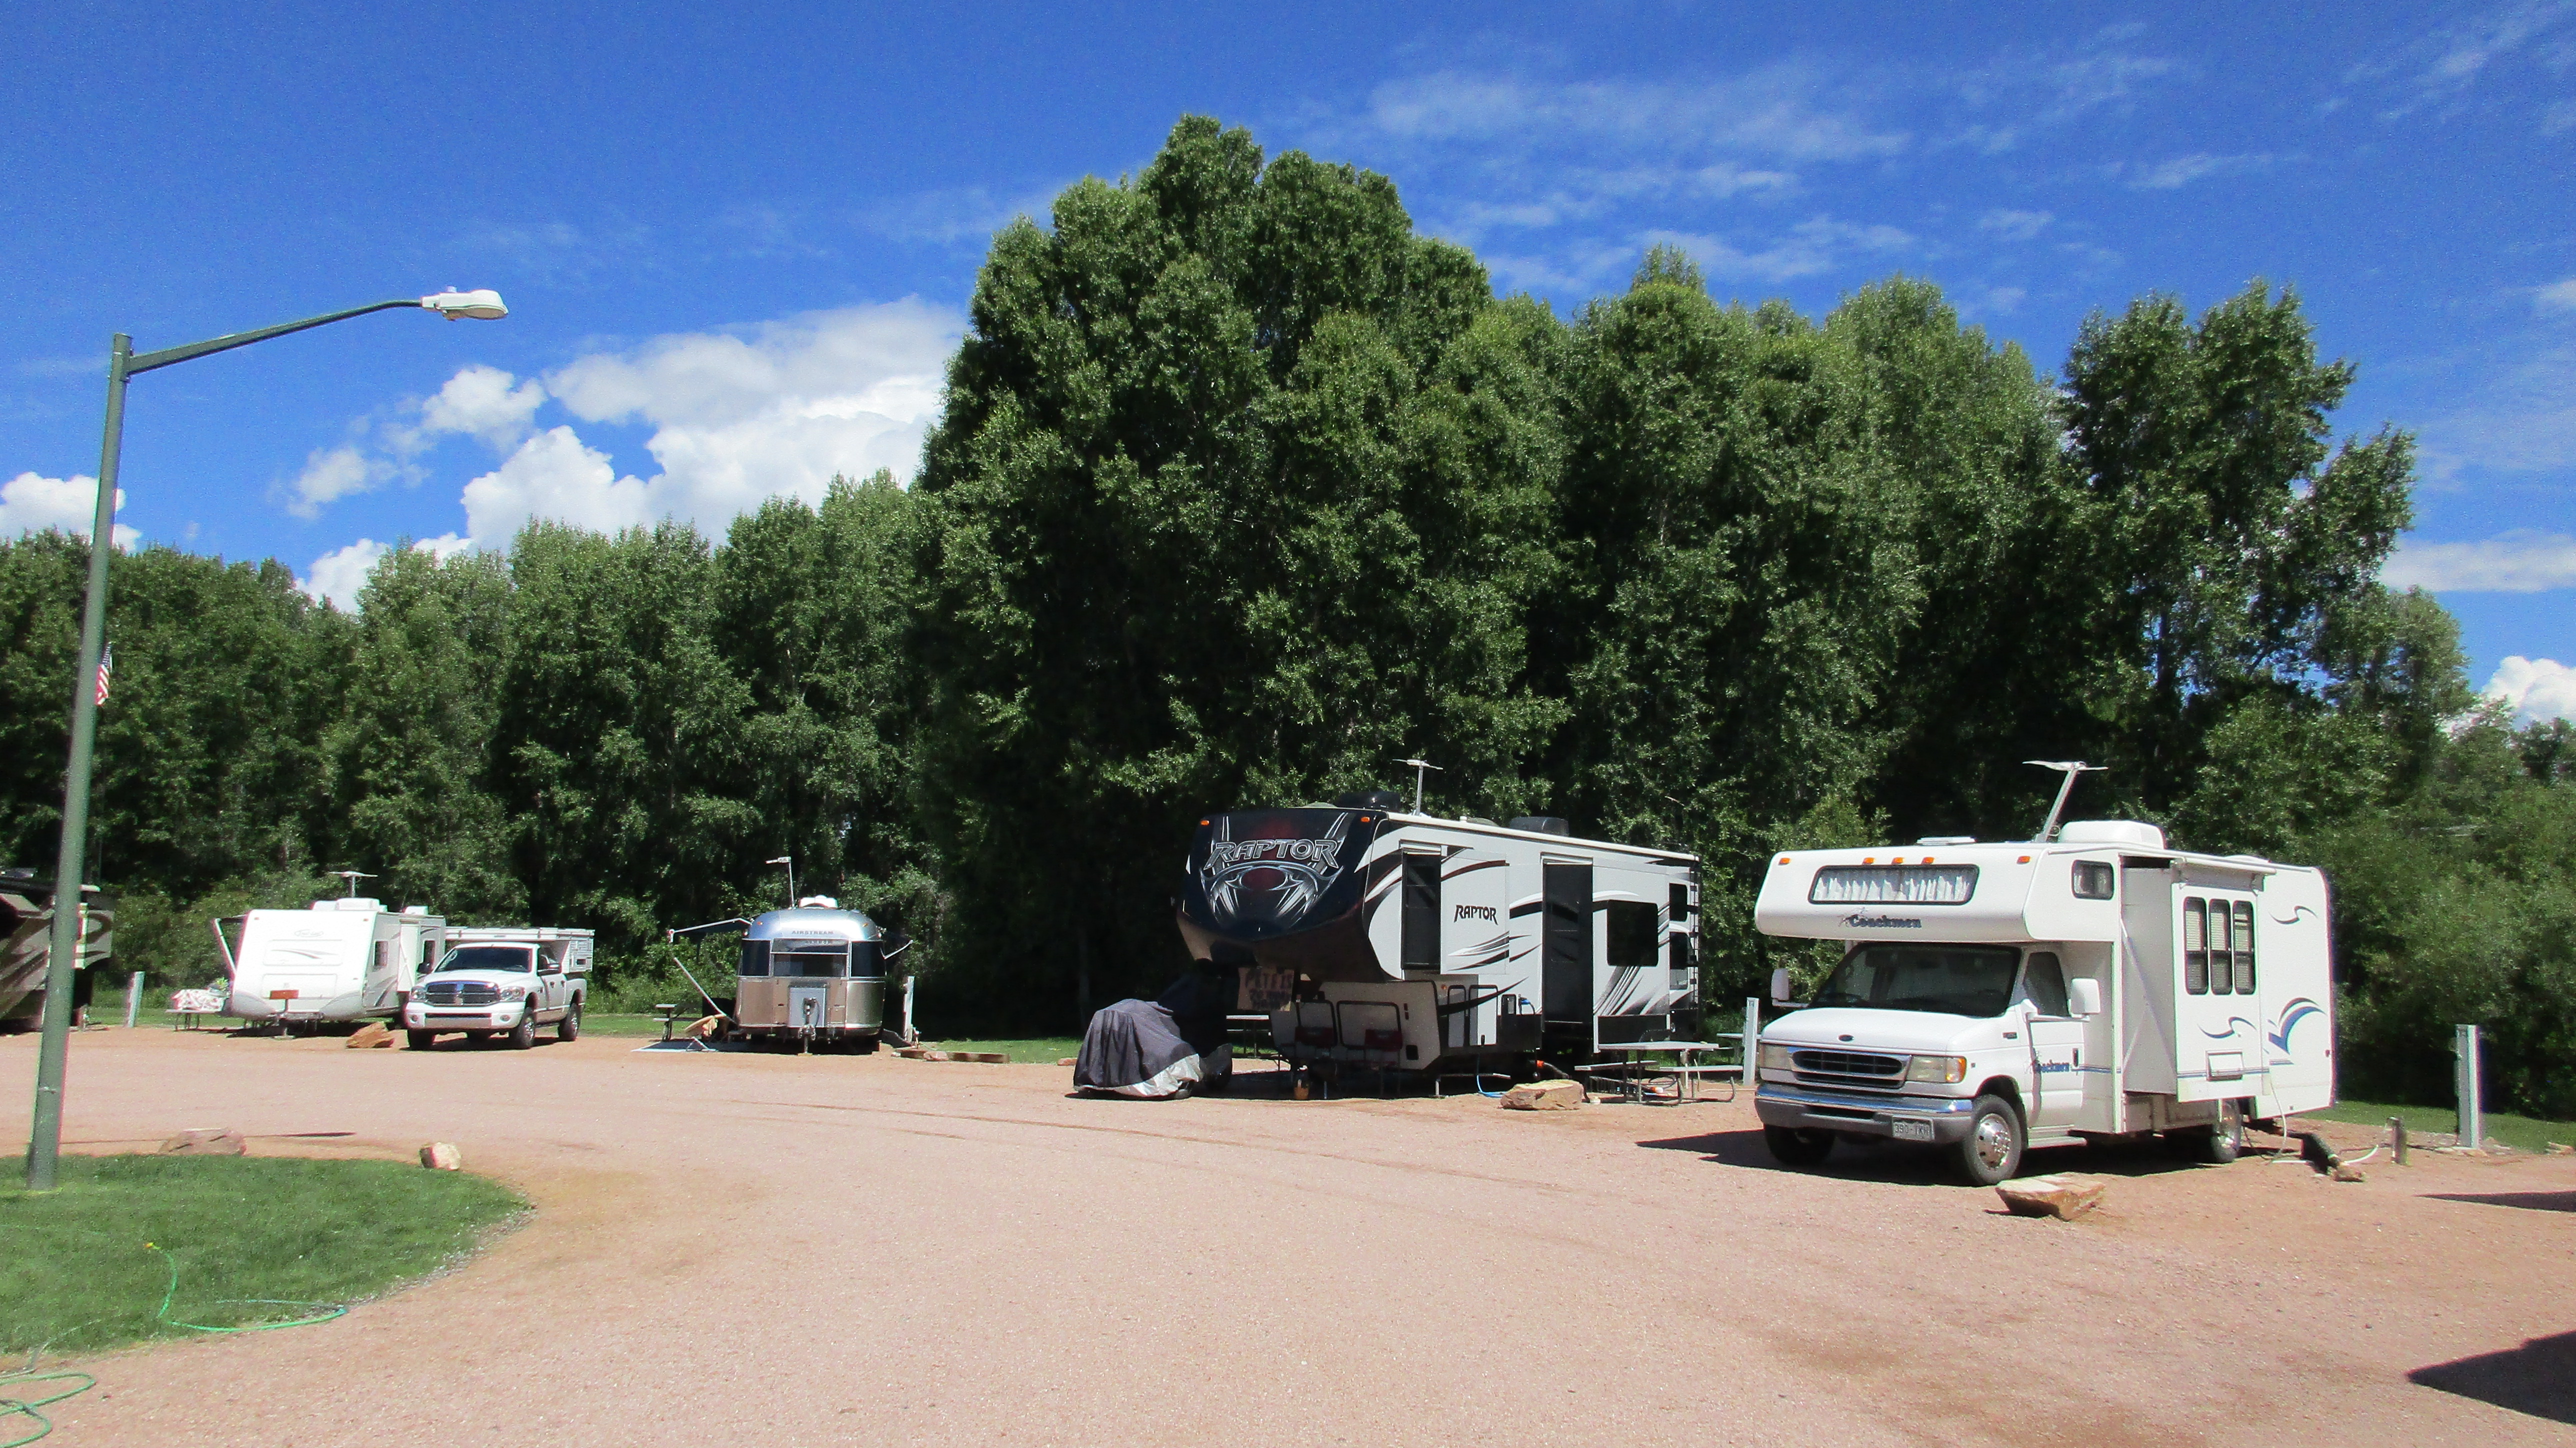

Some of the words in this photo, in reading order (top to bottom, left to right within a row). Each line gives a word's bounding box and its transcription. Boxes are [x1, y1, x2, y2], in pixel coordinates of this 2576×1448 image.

[1204, 839, 1339, 870] RAPTOR
[1454, 904, 1498, 926] RAPTOR
[1849, 914, 1922, 928] Coachmen
